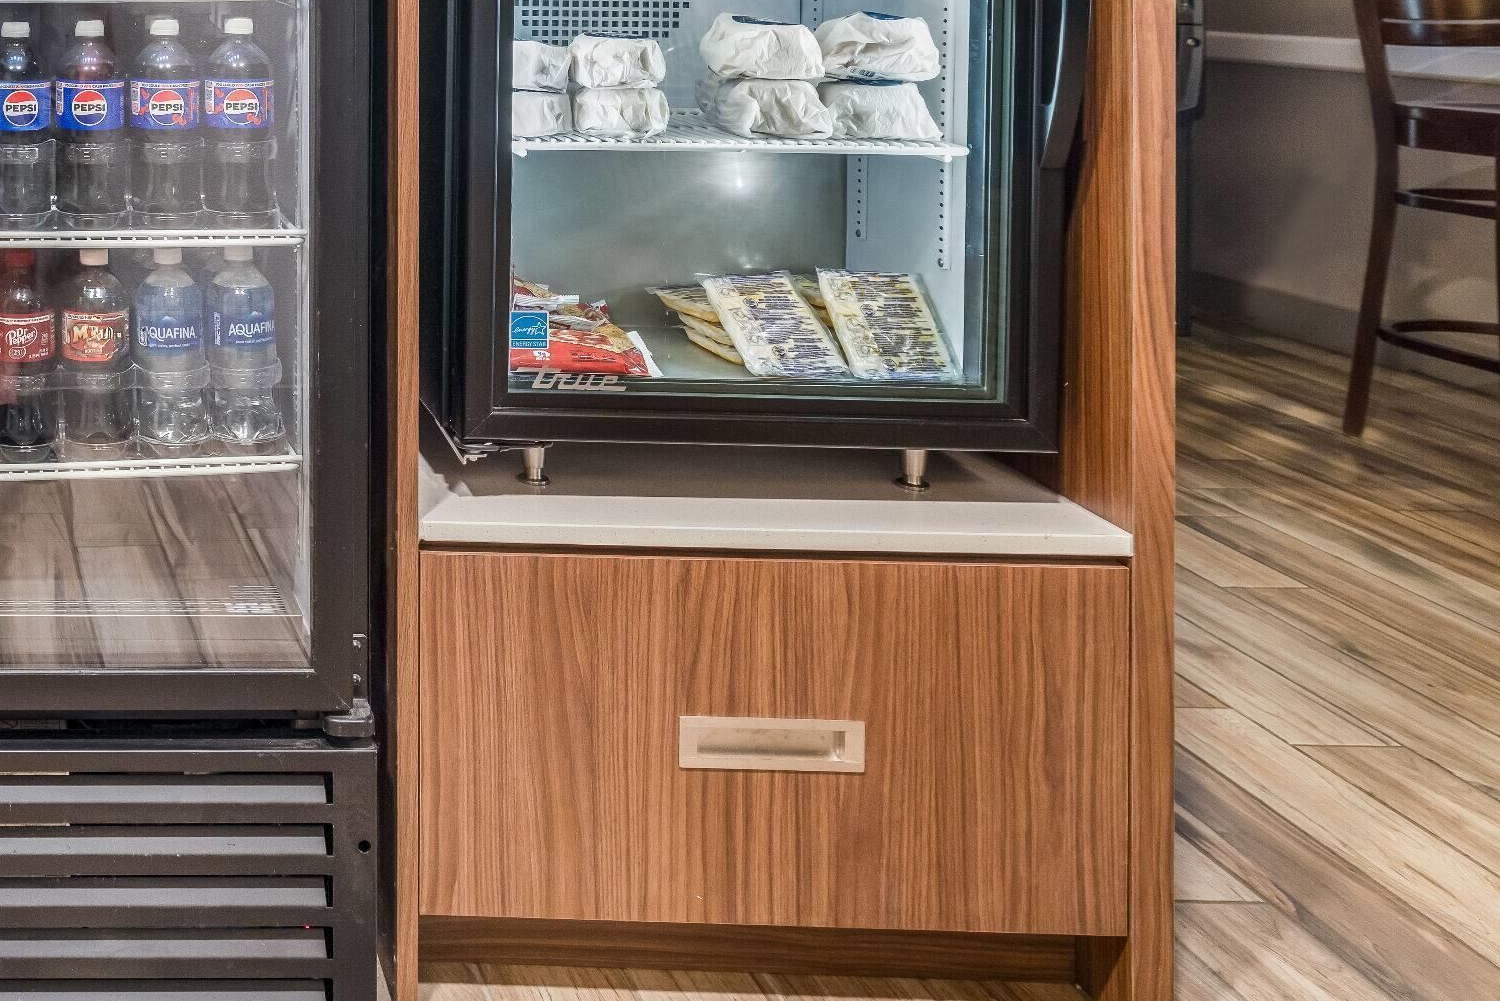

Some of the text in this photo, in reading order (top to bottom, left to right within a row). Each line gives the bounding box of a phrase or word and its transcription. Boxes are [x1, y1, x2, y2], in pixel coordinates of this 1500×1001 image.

[5, 103, 36, 112] PEPSI
[73, 103, 106, 112] PEPSI
[151, 103, 183, 111] PEPSI
[225, 102, 258, 111] PEPSI
[8, 330, 36, 346] Pepper
[148, 326, 196, 341] QUAFINA
[516, 365, 627, 392] true
